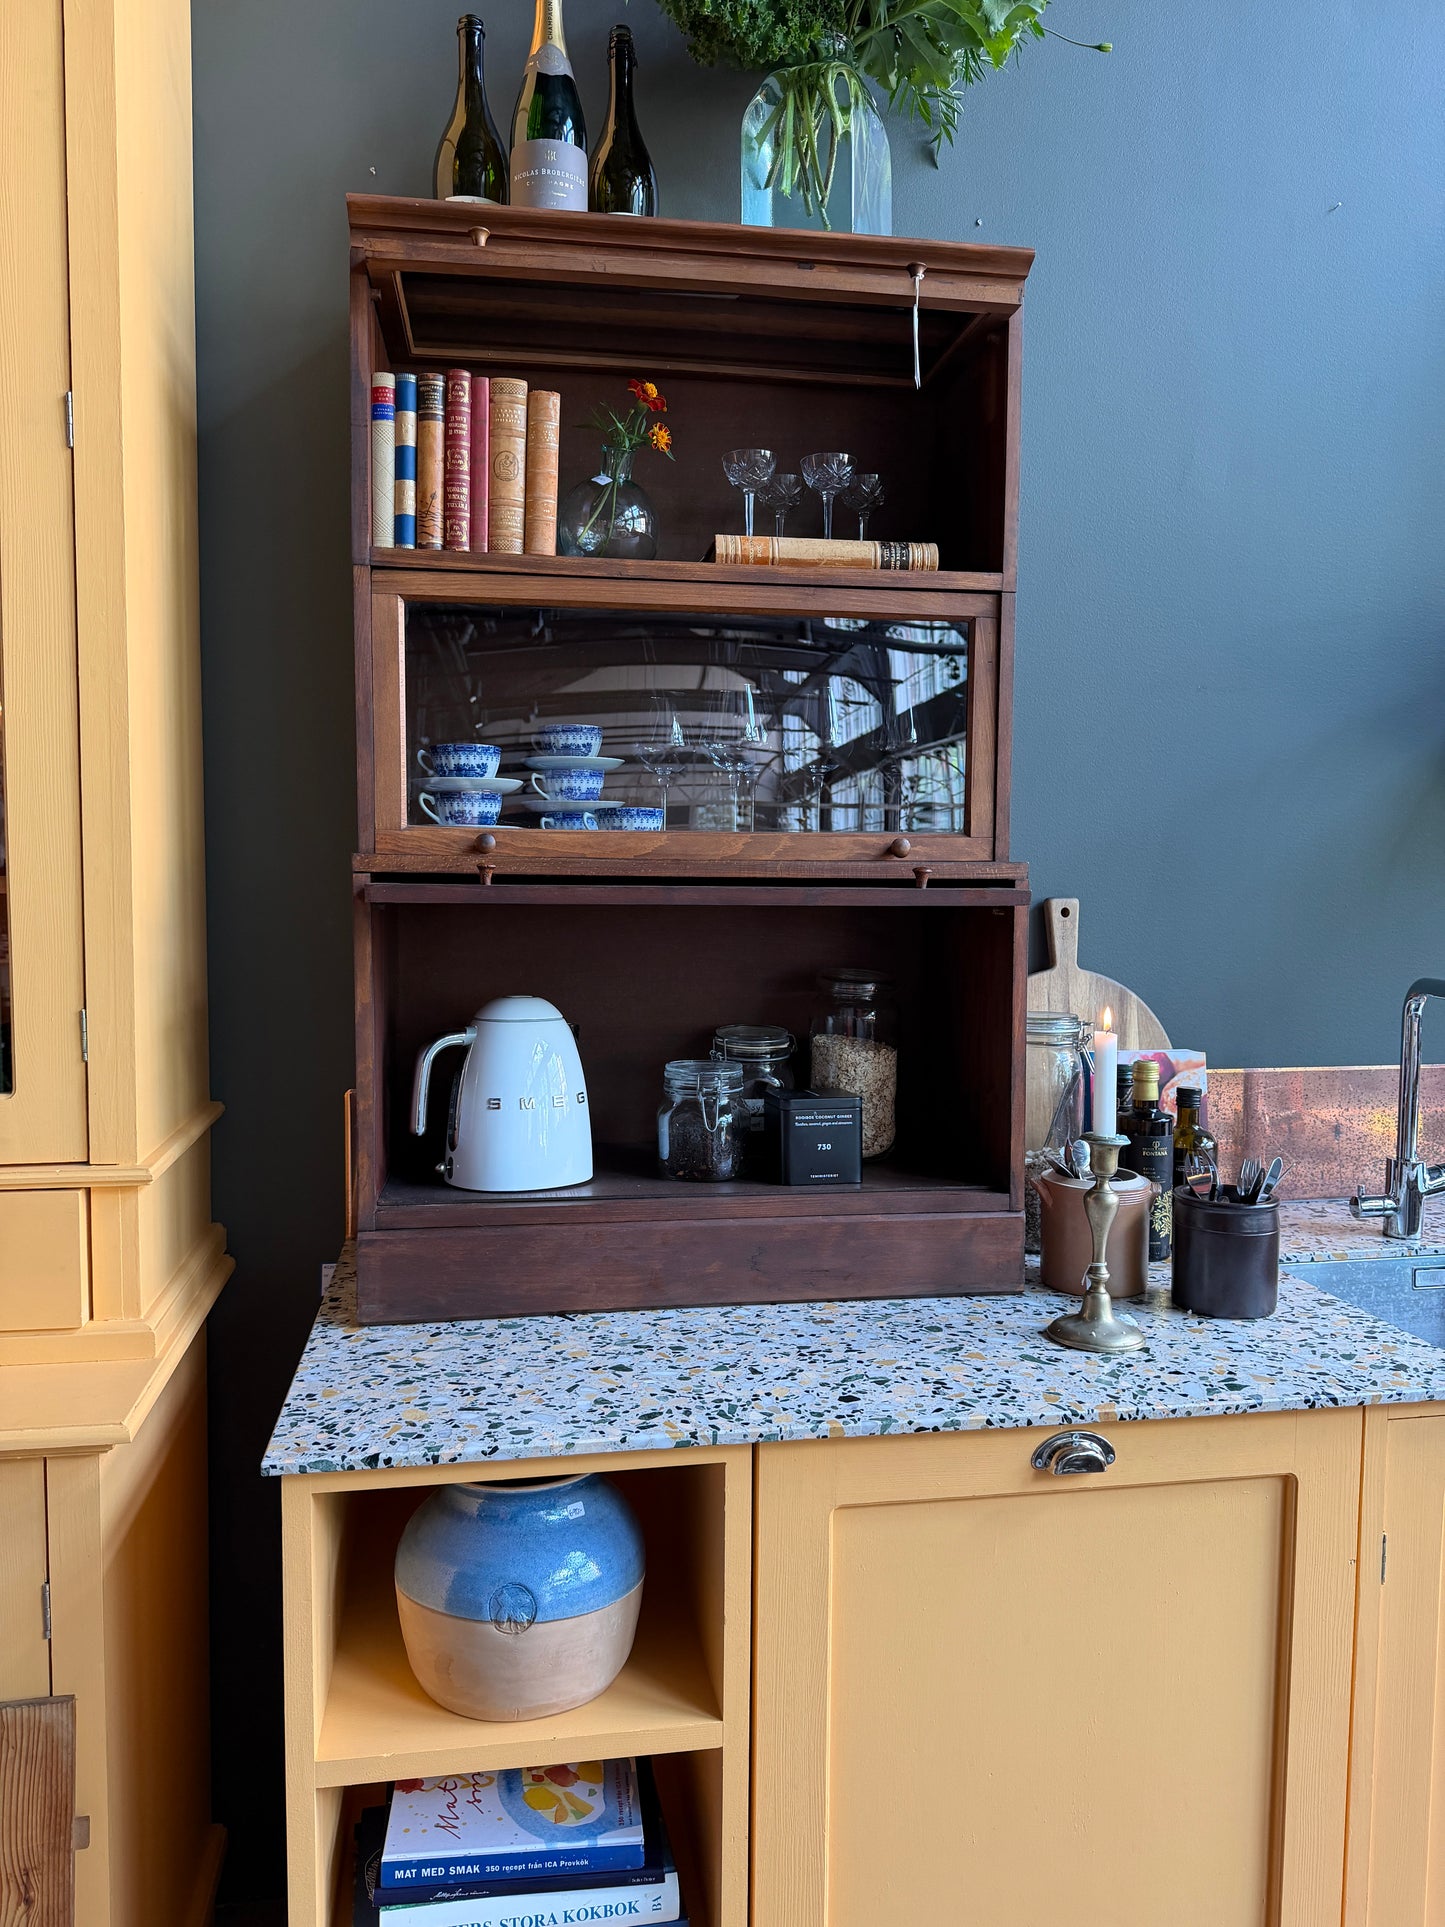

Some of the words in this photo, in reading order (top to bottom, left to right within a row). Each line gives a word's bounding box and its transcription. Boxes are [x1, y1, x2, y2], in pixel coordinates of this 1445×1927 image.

[514, 169, 539, 182] NICOLAS
[486, 1091, 585, 1110] SMEG
[434, 1779, 461, 1840] Mat
[394, 1869, 417, 1879] MAT
[421, 1867, 445, 1877] MED
[449, 1864, 480, 1875] SMAK
[485, 1864, 500, 1873] 350
[502, 1864, 526, 1872] recept
[528, 1861, 543, 1870] från
[559, 1859, 589, 1867] Provkök
[500, 1911, 558, 1927] STORA
[562, 1900, 640, 1924] KOKBOK
